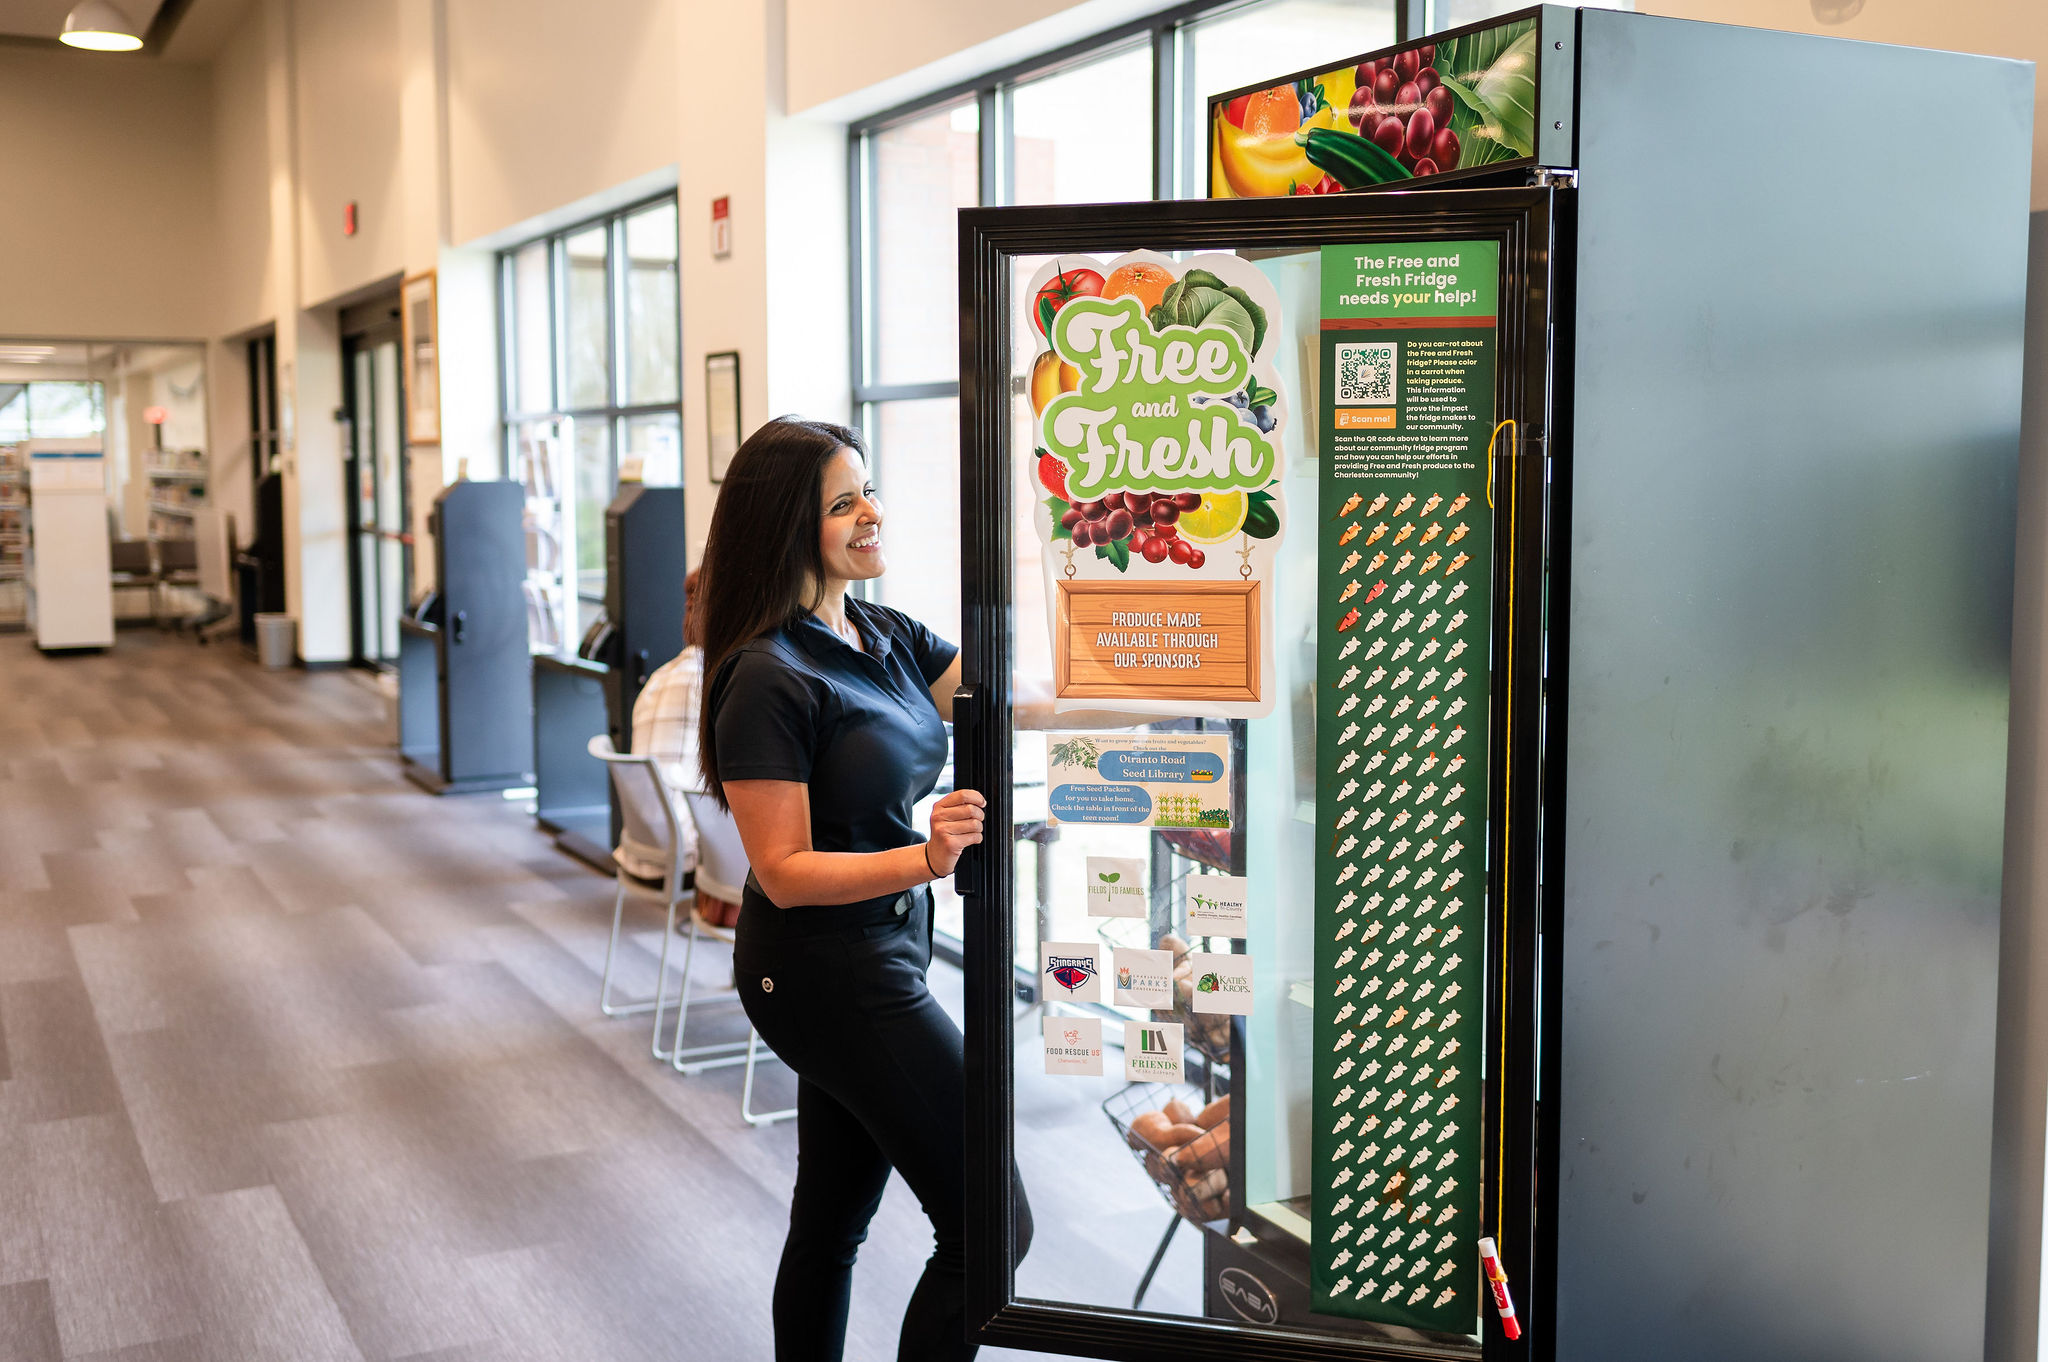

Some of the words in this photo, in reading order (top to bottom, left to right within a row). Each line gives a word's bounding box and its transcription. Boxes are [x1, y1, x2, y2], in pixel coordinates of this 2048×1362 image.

[1354, 256, 1384, 269] The
[1388, 256, 1423, 268] Free
[1427, 254, 1459, 268] and
[1356, 273, 1401, 287] Fresh
[1405, 272, 1457, 289] Fridge
[1340, 291, 1389, 305] needs
[1393, 293, 1431, 308] your
[1434, 290, 1476, 307] help!
[1066, 310, 1237, 393] Free
[1407, 359, 1432, 367] fridge?
[1407, 377, 1430, 385] taking
[1131, 395, 1179, 418] and
[1442, 405, 1468, 413] impact
[1419, 414, 1441, 422] fridge
[1420, 423, 1464, 431] community.
[1053, 406, 1264, 488] Fresh
[1370, 444, 1412, 453] community
[1413, 444, 1434, 452] fridge
[1375, 472, 1419, 480] community!
[1112, 612, 1163, 627] PRODUCE
[1167, 612, 1202, 627] MADE
[1096, 632, 1158, 648] AVAILABLE
[1163, 633, 1218, 648] THROUGH
[1114, 652, 1138, 668] OUR
[1141, 653, 1201, 668] SPONSORS
[1119, 754, 1158, 764] Otranto
[1160, 755, 1186, 765] Road
[1122, 768, 1146, 778] Seed
[1148, 769, 1184, 781] Library
[1104, 785, 1130, 793] Packets
[1088, 885, 1107, 894] FIELDS
[1111, 886, 1119, 894] TO
[1120, 886, 1144, 896] FAMILIES
[1133, 978, 1168, 987] PARKS
[1220, 975, 1247, 985] KATIE'S
[1064, 1048, 1089, 1056] RESCUE
[1132, 1059, 1178, 1070] FRIENDS
